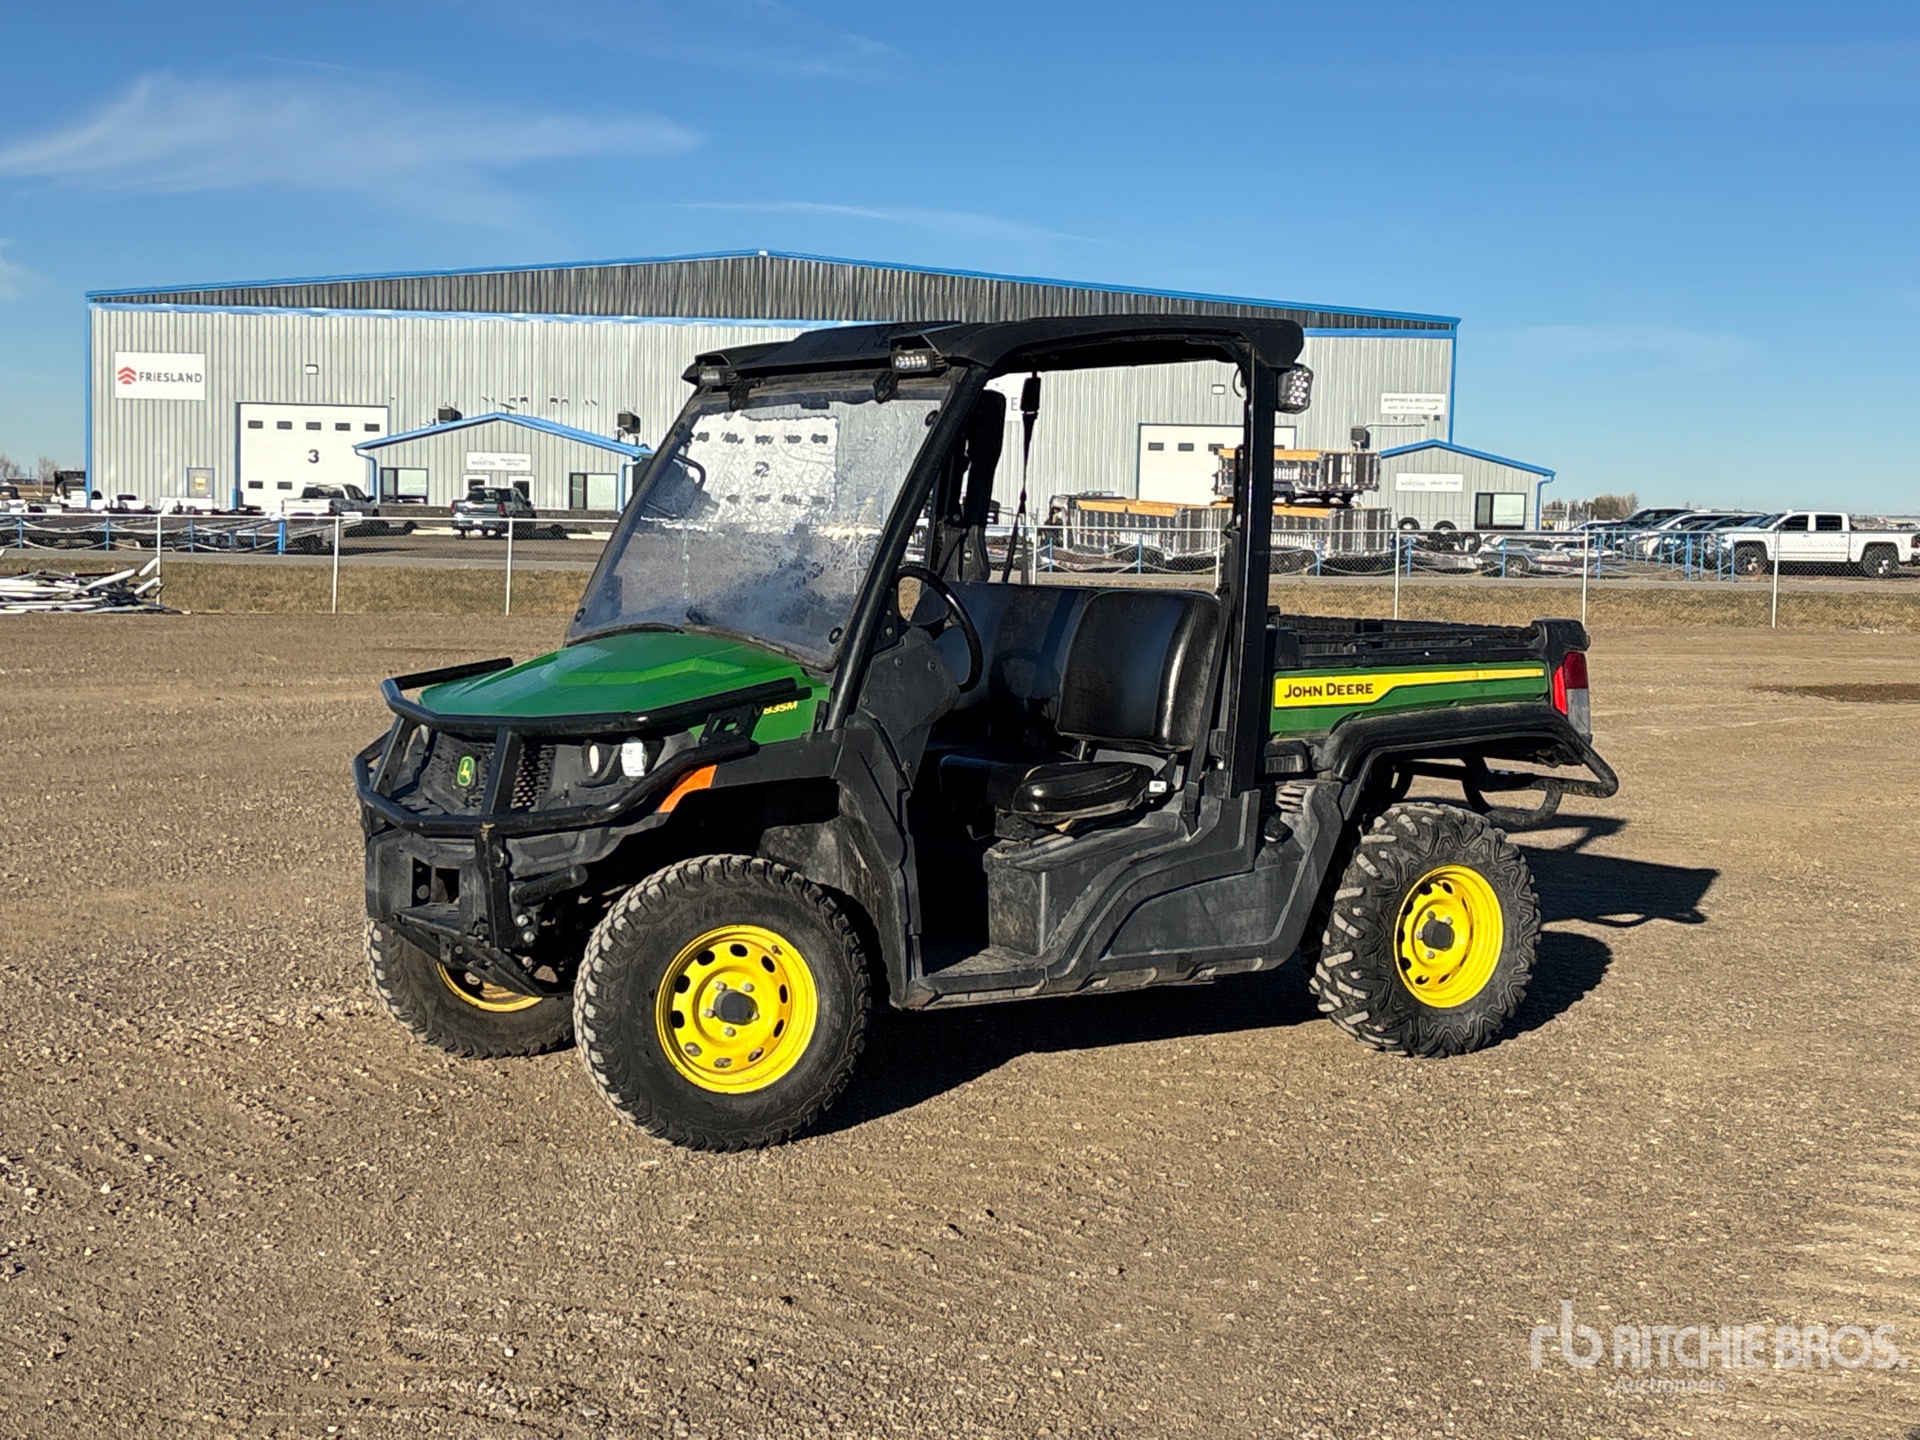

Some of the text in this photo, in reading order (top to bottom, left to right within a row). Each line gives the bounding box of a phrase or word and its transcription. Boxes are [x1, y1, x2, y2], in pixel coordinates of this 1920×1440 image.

[138, 371, 203, 384] FRIESLAND
[307, 448, 320, 464] 3
[1284, 682, 1374, 699] JOHN DEERE
